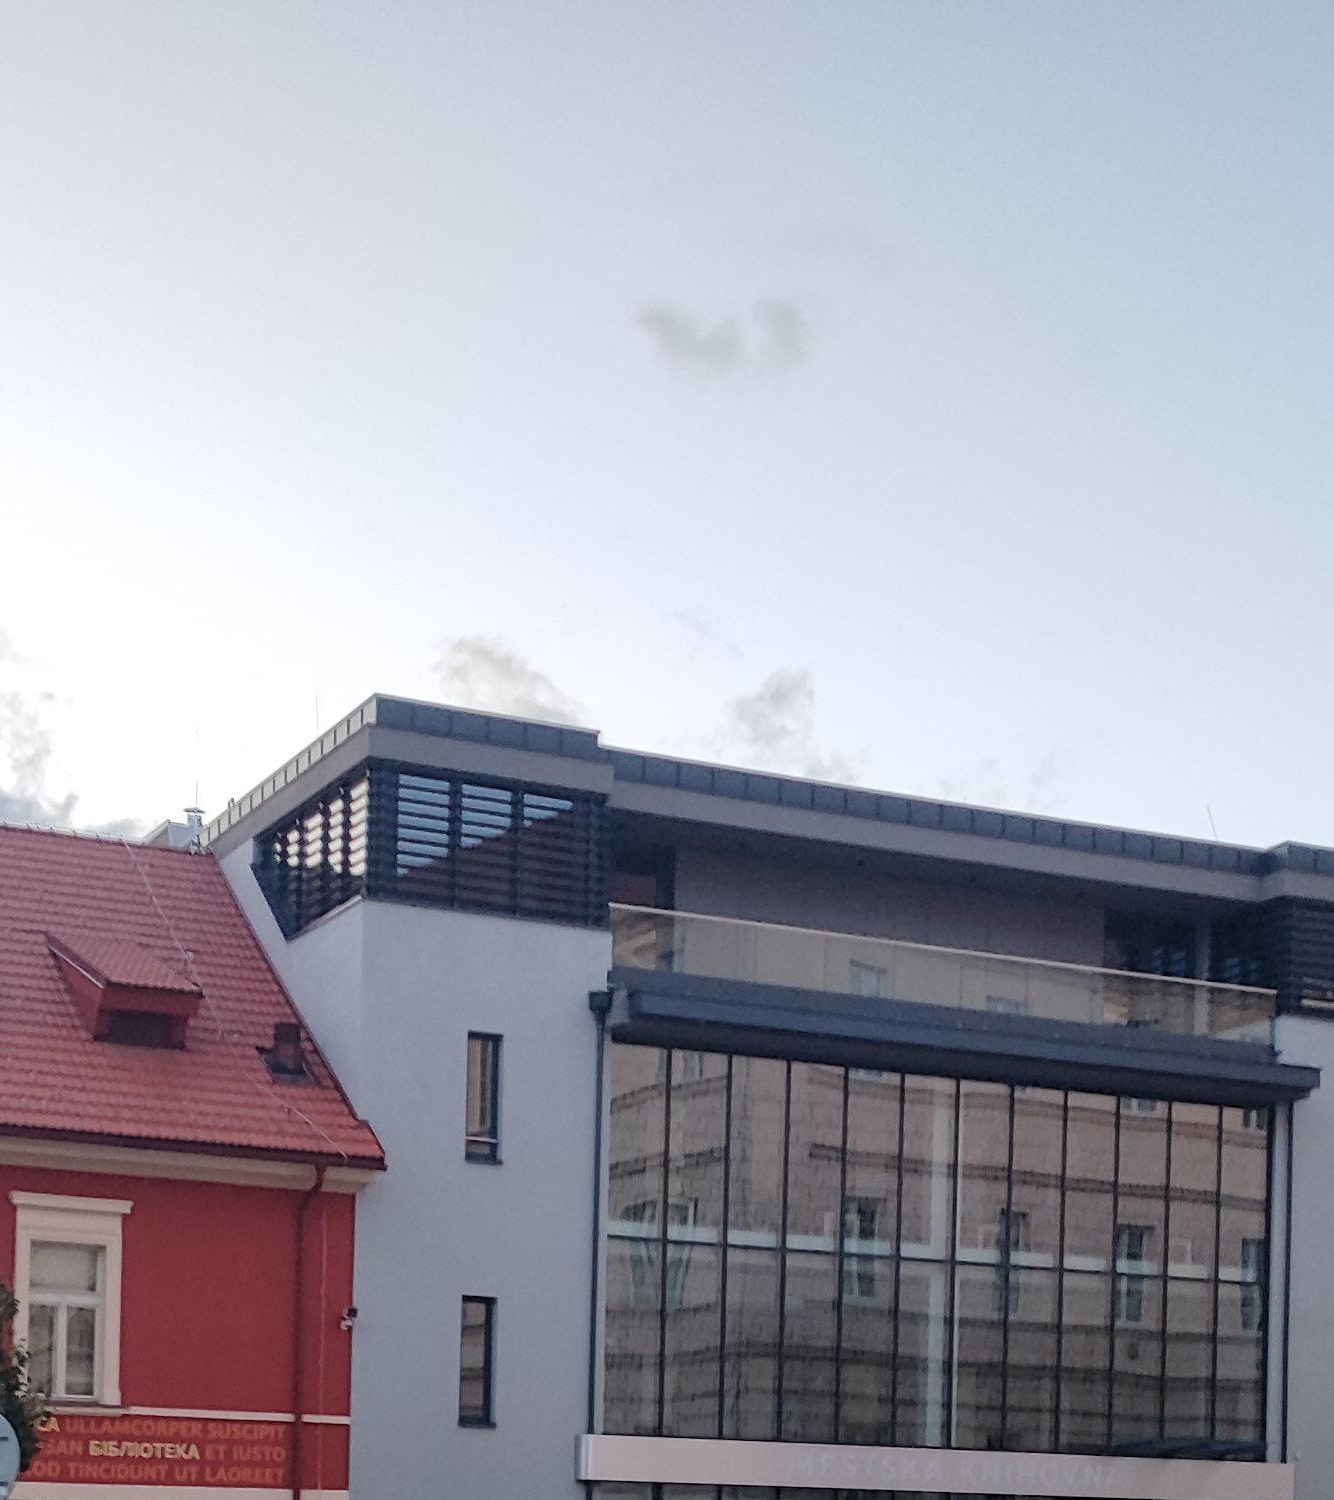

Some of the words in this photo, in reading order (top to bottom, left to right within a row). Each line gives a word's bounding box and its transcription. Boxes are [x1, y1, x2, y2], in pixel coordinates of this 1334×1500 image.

[65, 1418, 203, 1438] ULLAMCORPER
[207, 1423, 287, 1442] SUSCIPIT
[69, 1462, 168, 1482] TINCIDUNT
[204, 1467, 286, 1485] LAOREET
